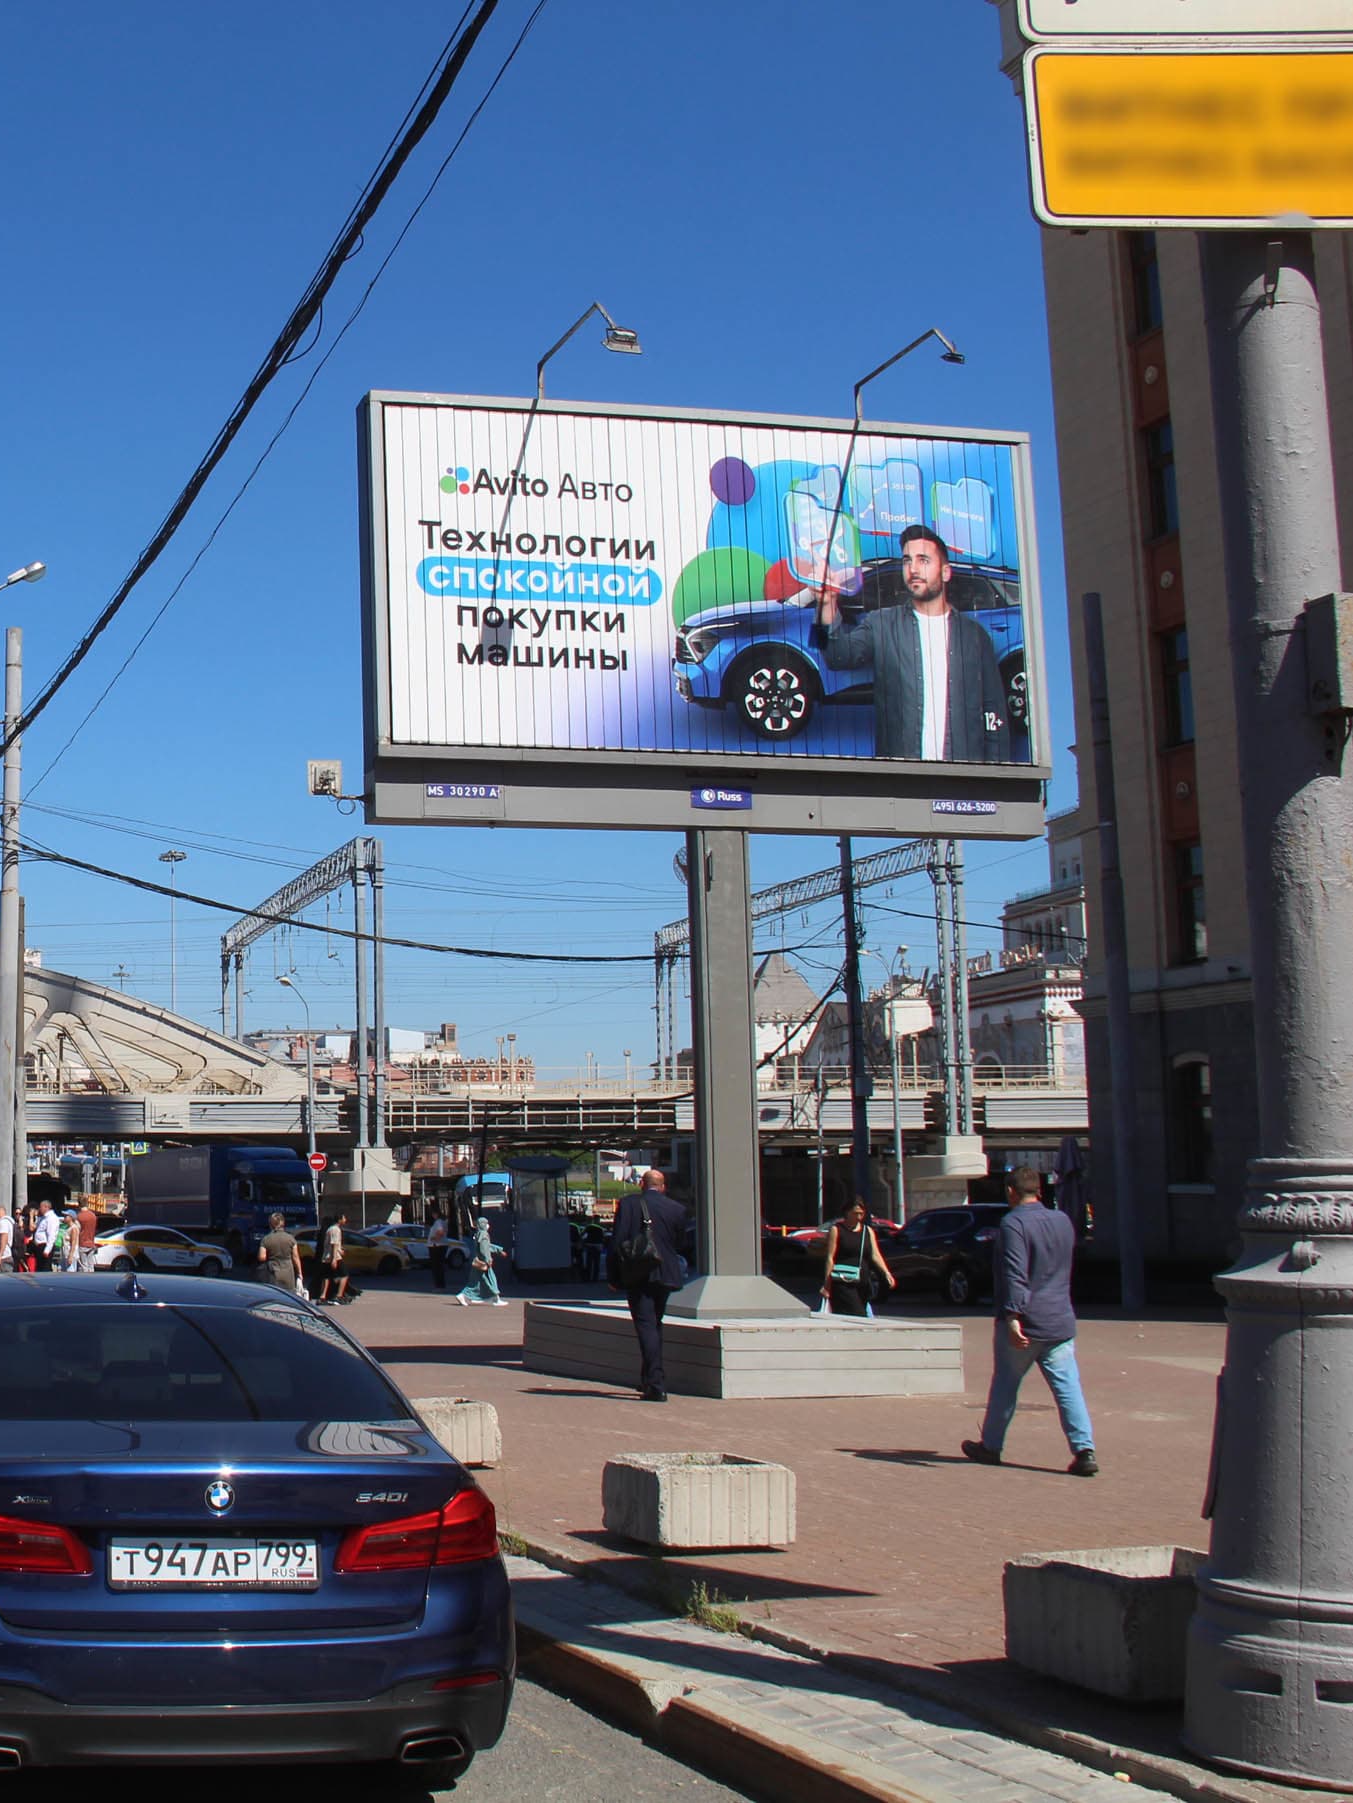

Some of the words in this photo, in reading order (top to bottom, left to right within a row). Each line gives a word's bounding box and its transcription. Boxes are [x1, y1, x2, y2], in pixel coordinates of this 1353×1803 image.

[473, 468, 548, 497] Avito
[558, 473, 633, 502] Авто
[418, 519, 656, 560] Технологии
[428, 561, 651, 598] спокойной
[456, 604, 626, 637] покупки
[456, 642, 628, 671] машины
[984, 712, 1003, 731] 12+
[428, 786, 444, 796] MS
[449, 786, 486, 797] 30290
[717, 791, 743, 802] Russ
[956, 802, 996, 812] 626-5200
[123, 1542, 252, 1576] Т947АР
[259, 1541, 308, 1567] 799
[271, 1567, 296, 1578] RUS
